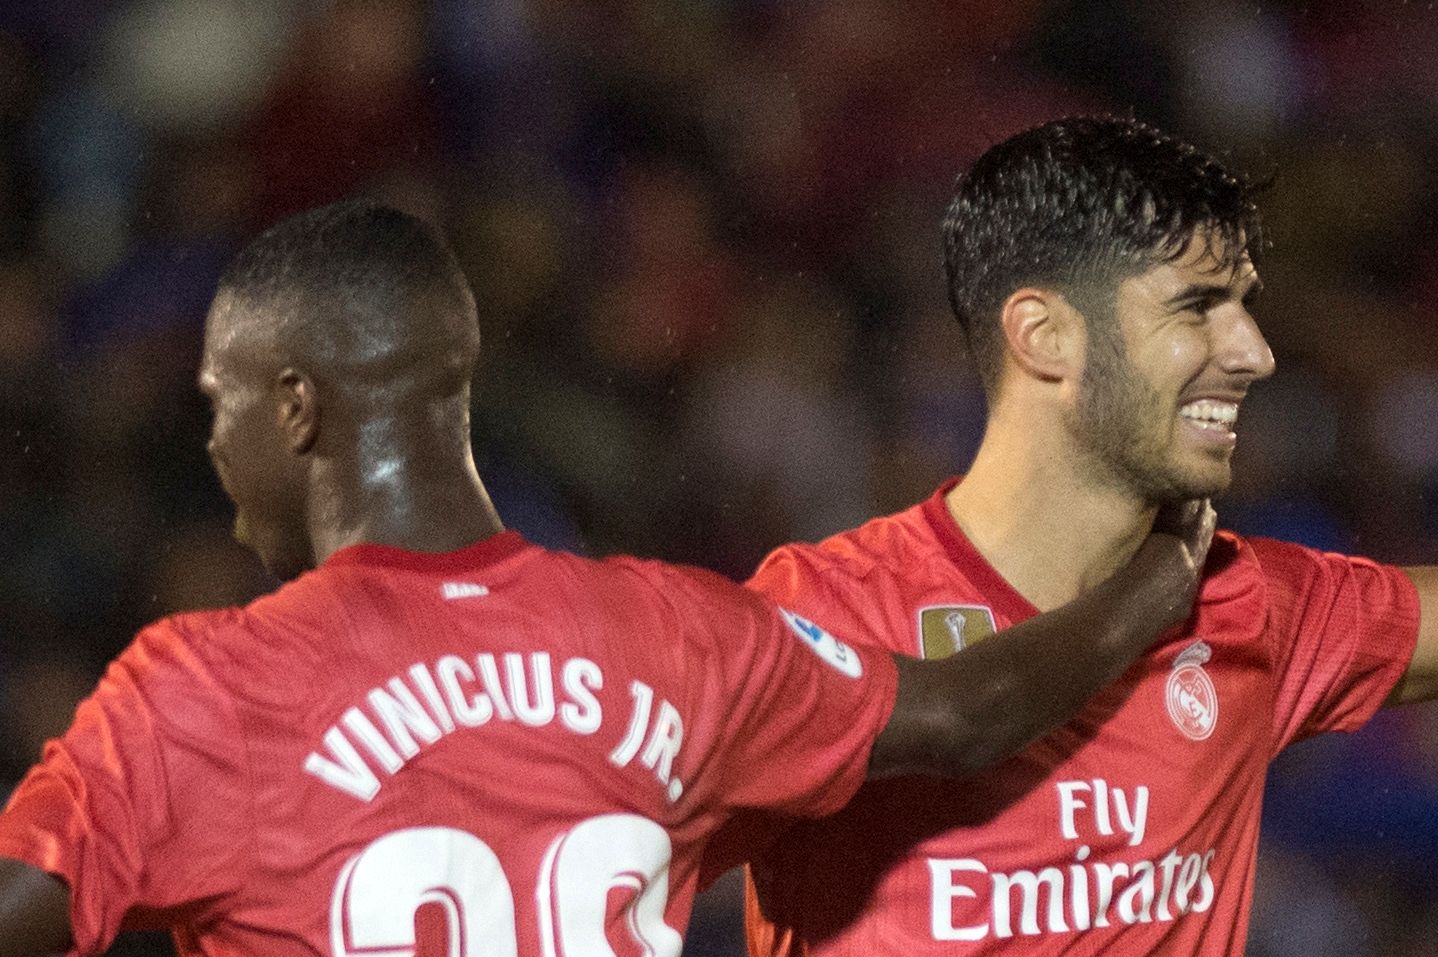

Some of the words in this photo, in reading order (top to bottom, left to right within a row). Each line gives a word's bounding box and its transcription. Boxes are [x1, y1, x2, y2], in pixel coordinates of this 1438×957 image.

[304, 652, 605, 802] VINICIUS
[609, 680, 685, 801] JR.
[1056, 778, 1150, 846] Fly
[928, 845, 1216, 941] Emirates
